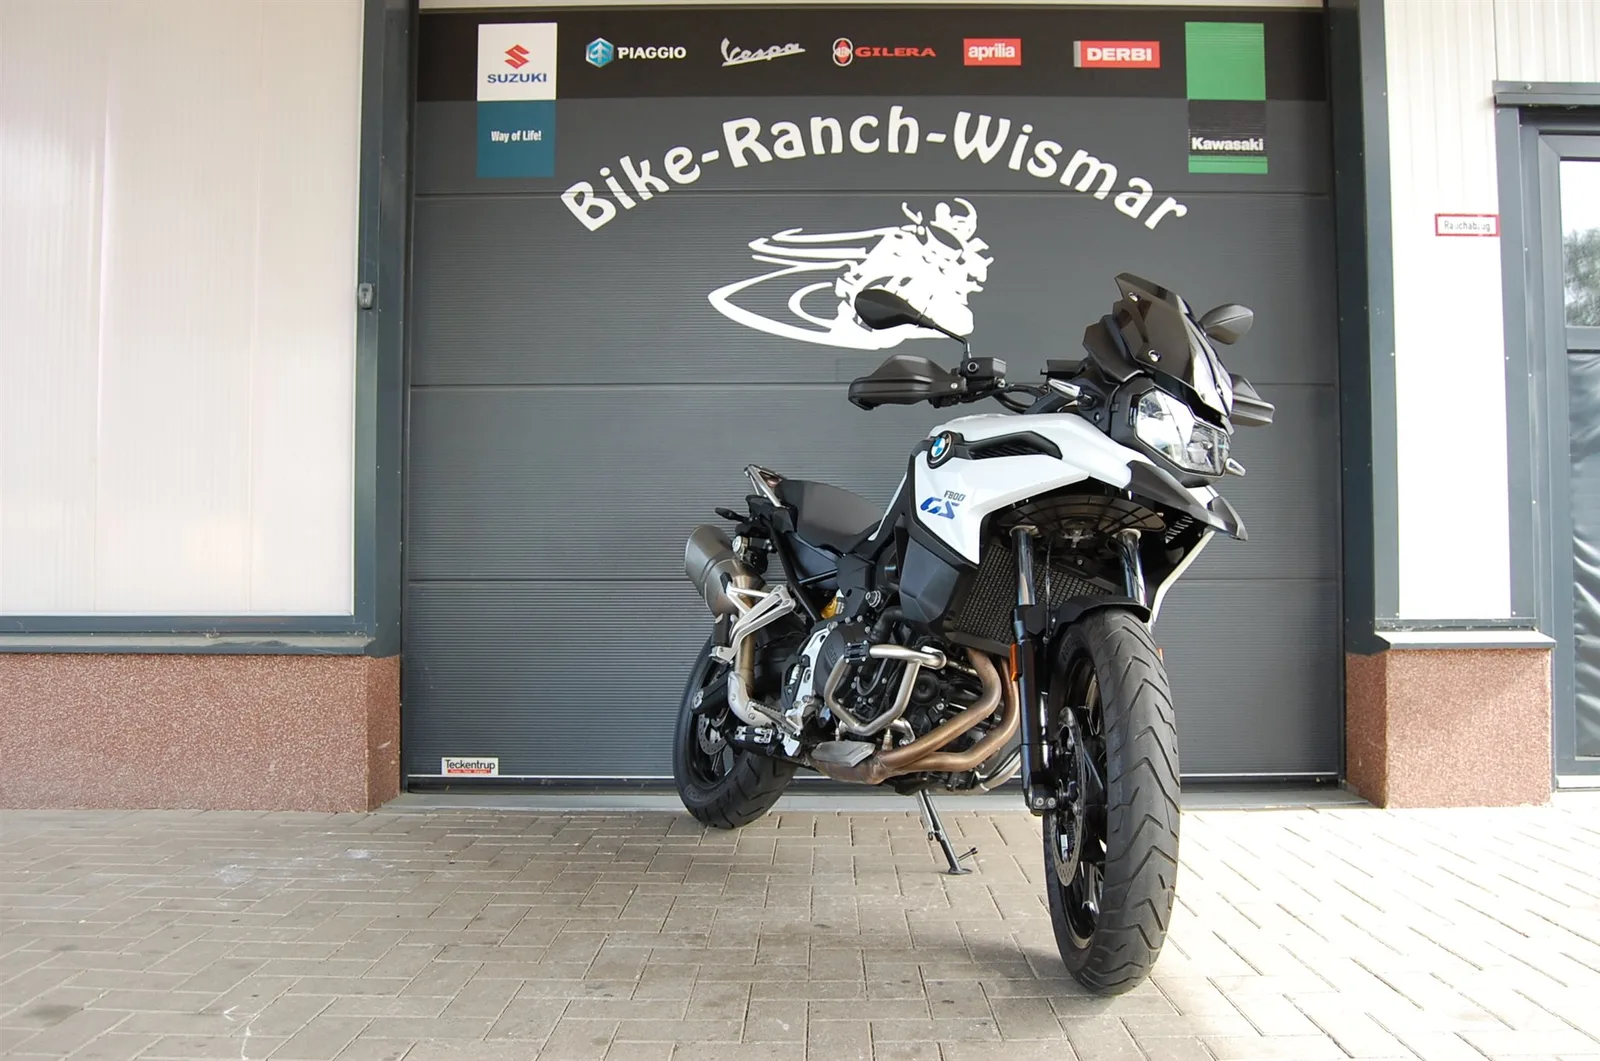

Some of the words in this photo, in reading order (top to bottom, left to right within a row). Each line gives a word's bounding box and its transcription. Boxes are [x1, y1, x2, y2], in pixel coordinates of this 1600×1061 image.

[617, 46, 687, 60] PIAGGIO
[720, 37, 806, 67] Vespa
[854, 46, 937, 58] GILERA
[968, 43, 1016, 61] aprilia
[1086, 47, 1153, 62] DERBI
[487, 73, 547, 84] SUZUKI
[490, 130, 510, 143] Way
[511, 130, 521, 142] of
[522, 129, 542, 142] Life!
[1191, 136, 1264, 151] Kawasaki
[560, 105, 1188, 232] Bike-Ranch-Wismar
[920, 496, 960, 519] GS
[444, 759, 496, 771] Teckentrup
